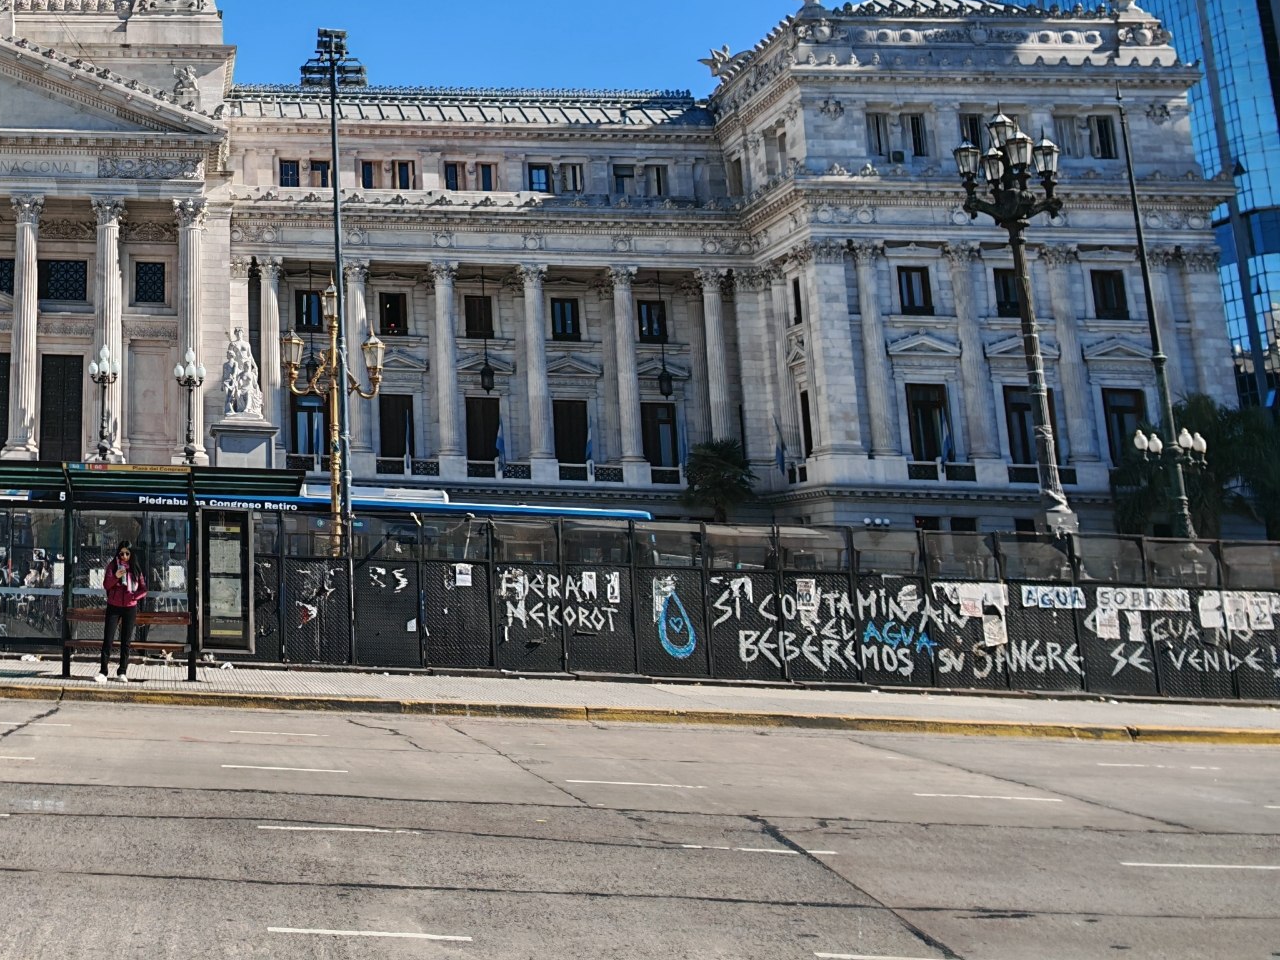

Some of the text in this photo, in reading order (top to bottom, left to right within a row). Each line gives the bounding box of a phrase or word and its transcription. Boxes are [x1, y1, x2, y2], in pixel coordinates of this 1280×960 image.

[0, 159, 83, 175] NACIONAL
[209, 499, 262, 509] Congreso
[264, 501, 298, 511] Retiro
[797, 591, 812, 603] NO
[1025, 588, 1084, 608] AGUA
[1100, 589, 1191, 611] SOBRAN
[863, 620, 938, 659] AGUA
[738, 626, 915, 678] BEBEREMOS
[1110, 642, 1153, 677] SE
